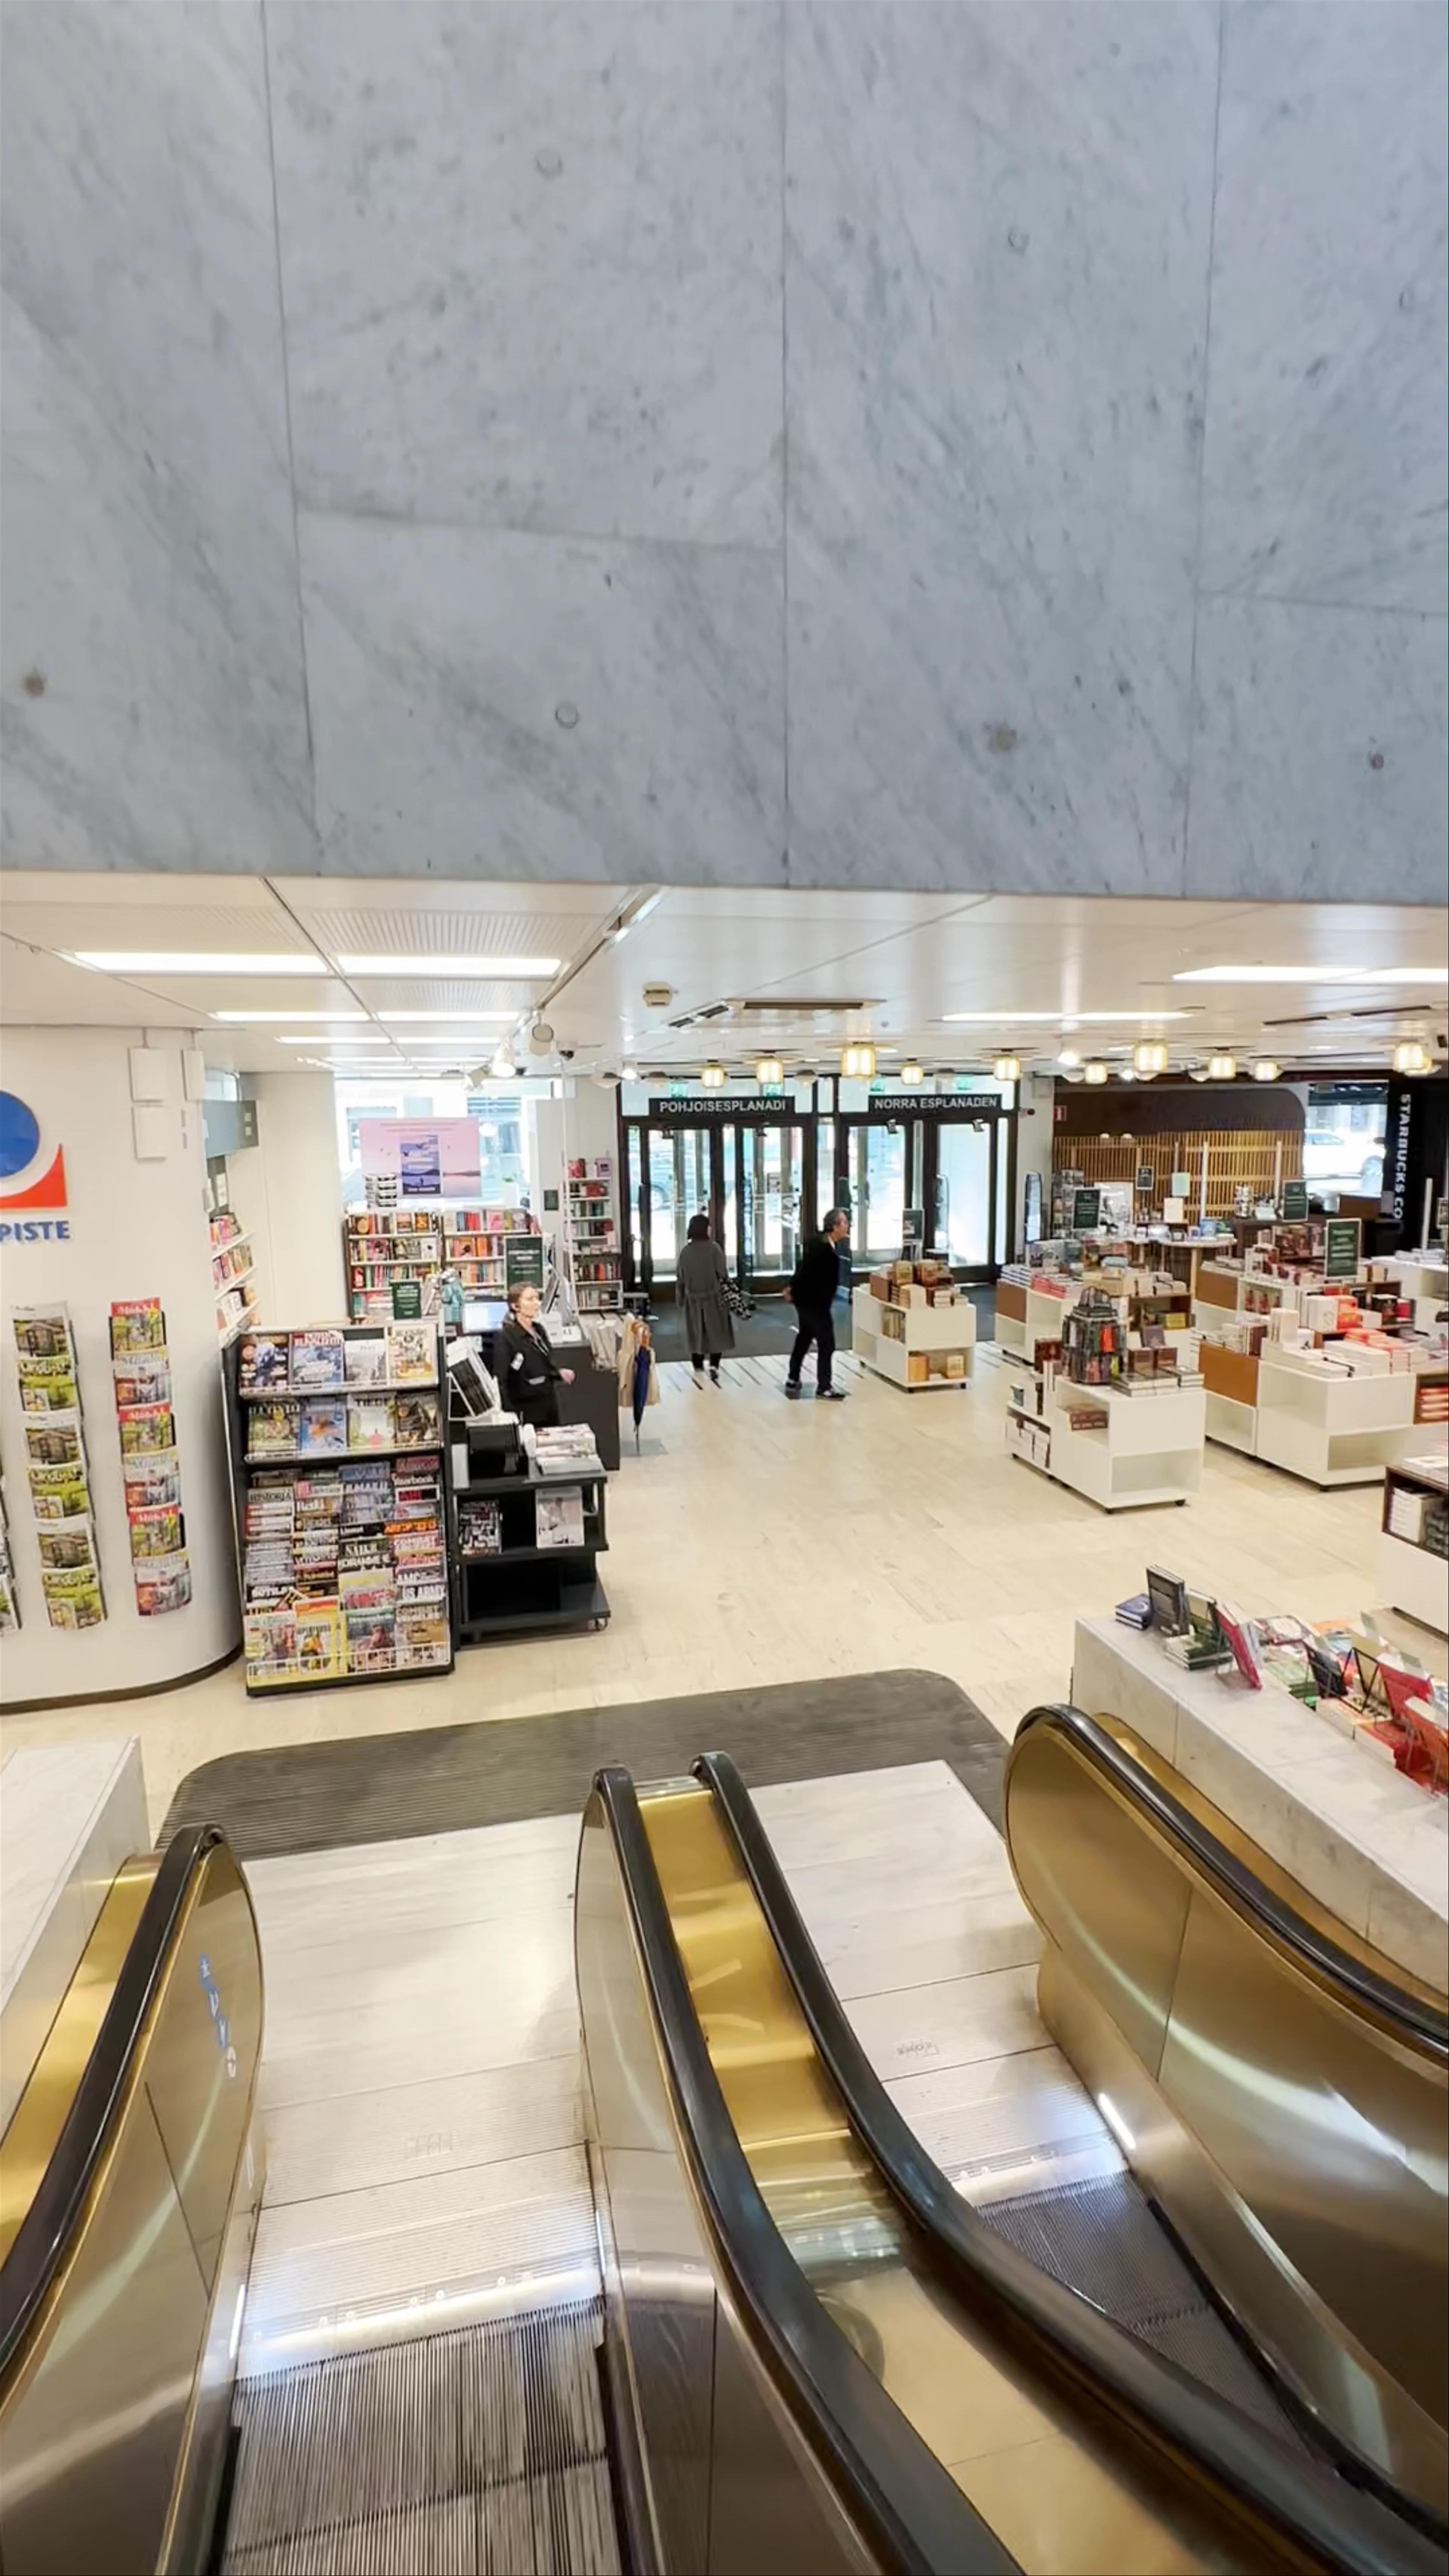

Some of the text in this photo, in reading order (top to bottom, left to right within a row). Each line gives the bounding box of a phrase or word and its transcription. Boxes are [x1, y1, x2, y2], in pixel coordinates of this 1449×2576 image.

[660, 1100, 786, 1113] POHJOISESPLANADI
[874, 1096, 997, 1109] NORRA ESPLANADEN
[1395, 1093, 1411, 1193] STARBUCKS
